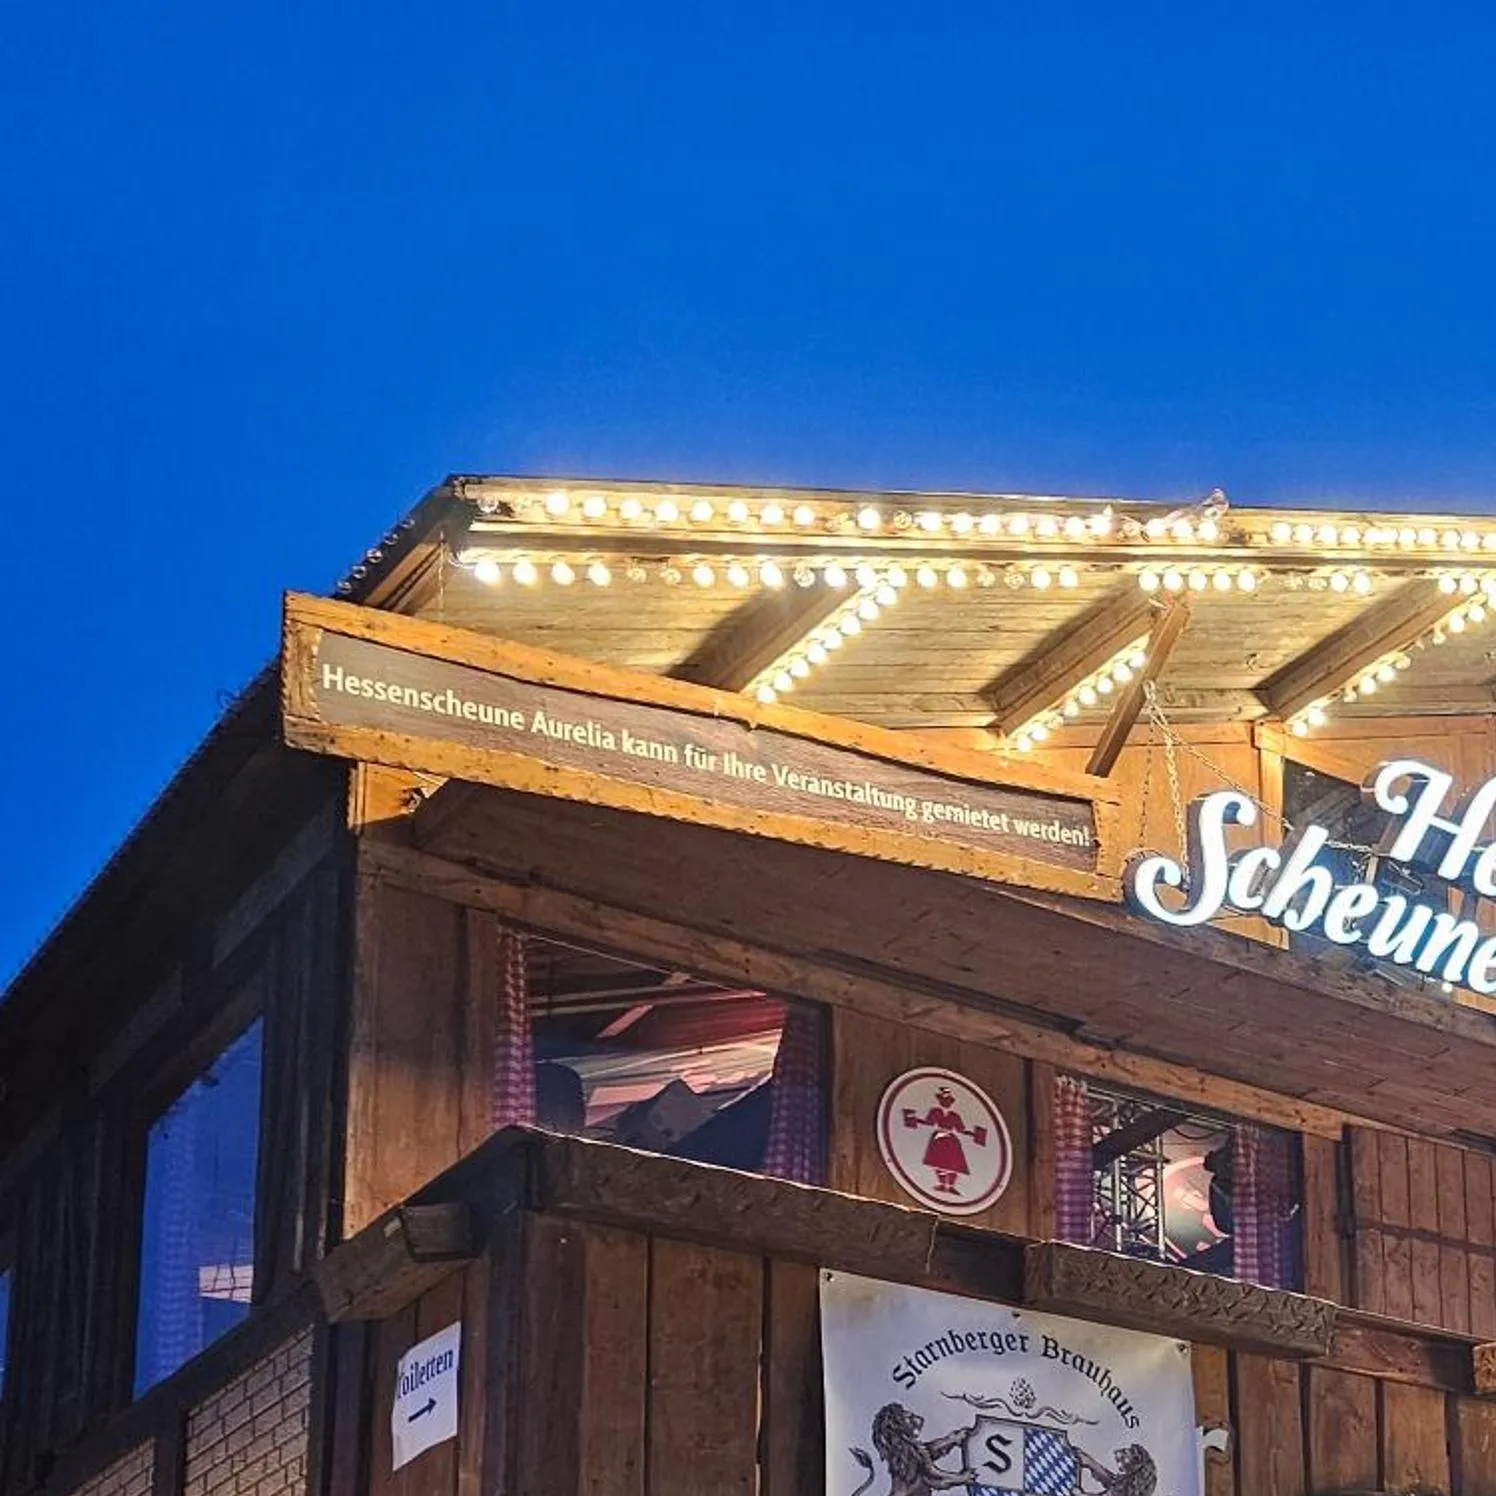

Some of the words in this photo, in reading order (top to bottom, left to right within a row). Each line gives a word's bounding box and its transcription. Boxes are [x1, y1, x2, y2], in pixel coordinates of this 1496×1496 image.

[322, 663, 526, 730] Hessenscheune
[530, 709, 615, 752] Aurelia
[622, 728, 679, 764] kann
[684, 743, 715, 770] für
[723, 751, 766, 784] Ihre
[774, 764, 917, 821] Veranstaltung
[921, 797, 1011, 834] gemietet
[1013, 816, 1092, 847] werden!
[893, 1327, 1030, 1391] Starnberger
[1040, 1334, 1141, 1430] Brauhaus
[984, 1433, 1012, 1475] S
